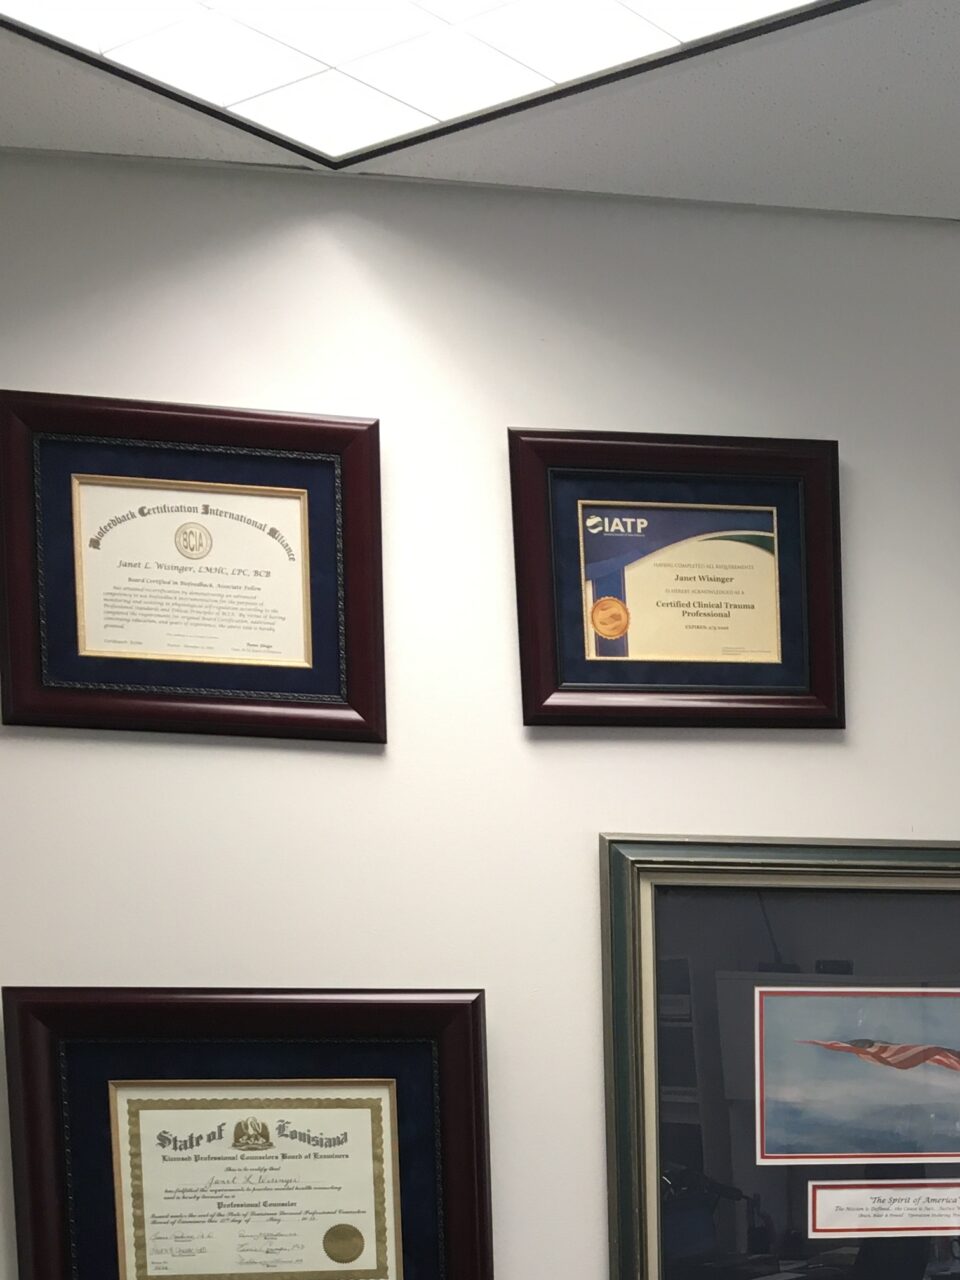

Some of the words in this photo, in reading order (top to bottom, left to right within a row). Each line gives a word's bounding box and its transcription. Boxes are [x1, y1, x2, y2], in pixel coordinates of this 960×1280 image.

[604, 517, 648, 533] IATP
[88, 510, 137, 550] Biofeedback
[138, 504, 198, 517] Certification
[201, 504, 267, 532] International
[267, 527, 296, 562] Alliance
[182, 530, 203, 552] BCIA
[117, 560, 142, 569] Janet
[698, 575, 735, 584] Wisinger
[656, 600, 691, 608] Certified
[693, 601, 722, 609] Clinical
[724, 602, 755, 610] Trauma
[682, 610, 731, 618] Professional
[155, 1130, 203, 1151] State
[206, 1122, 226, 1143] of
[276, 1119, 348, 1148] Louisiana
[193, 1154, 238, 1162] Professional
[240, 1153, 279, 1161] Counselors
[216, 1201, 260, 1210] Professional
[262, 1200, 297, 1208] Counselor
[888, 1196, 911, 1206] Spirit
[913, 1196, 921, 1205] of
